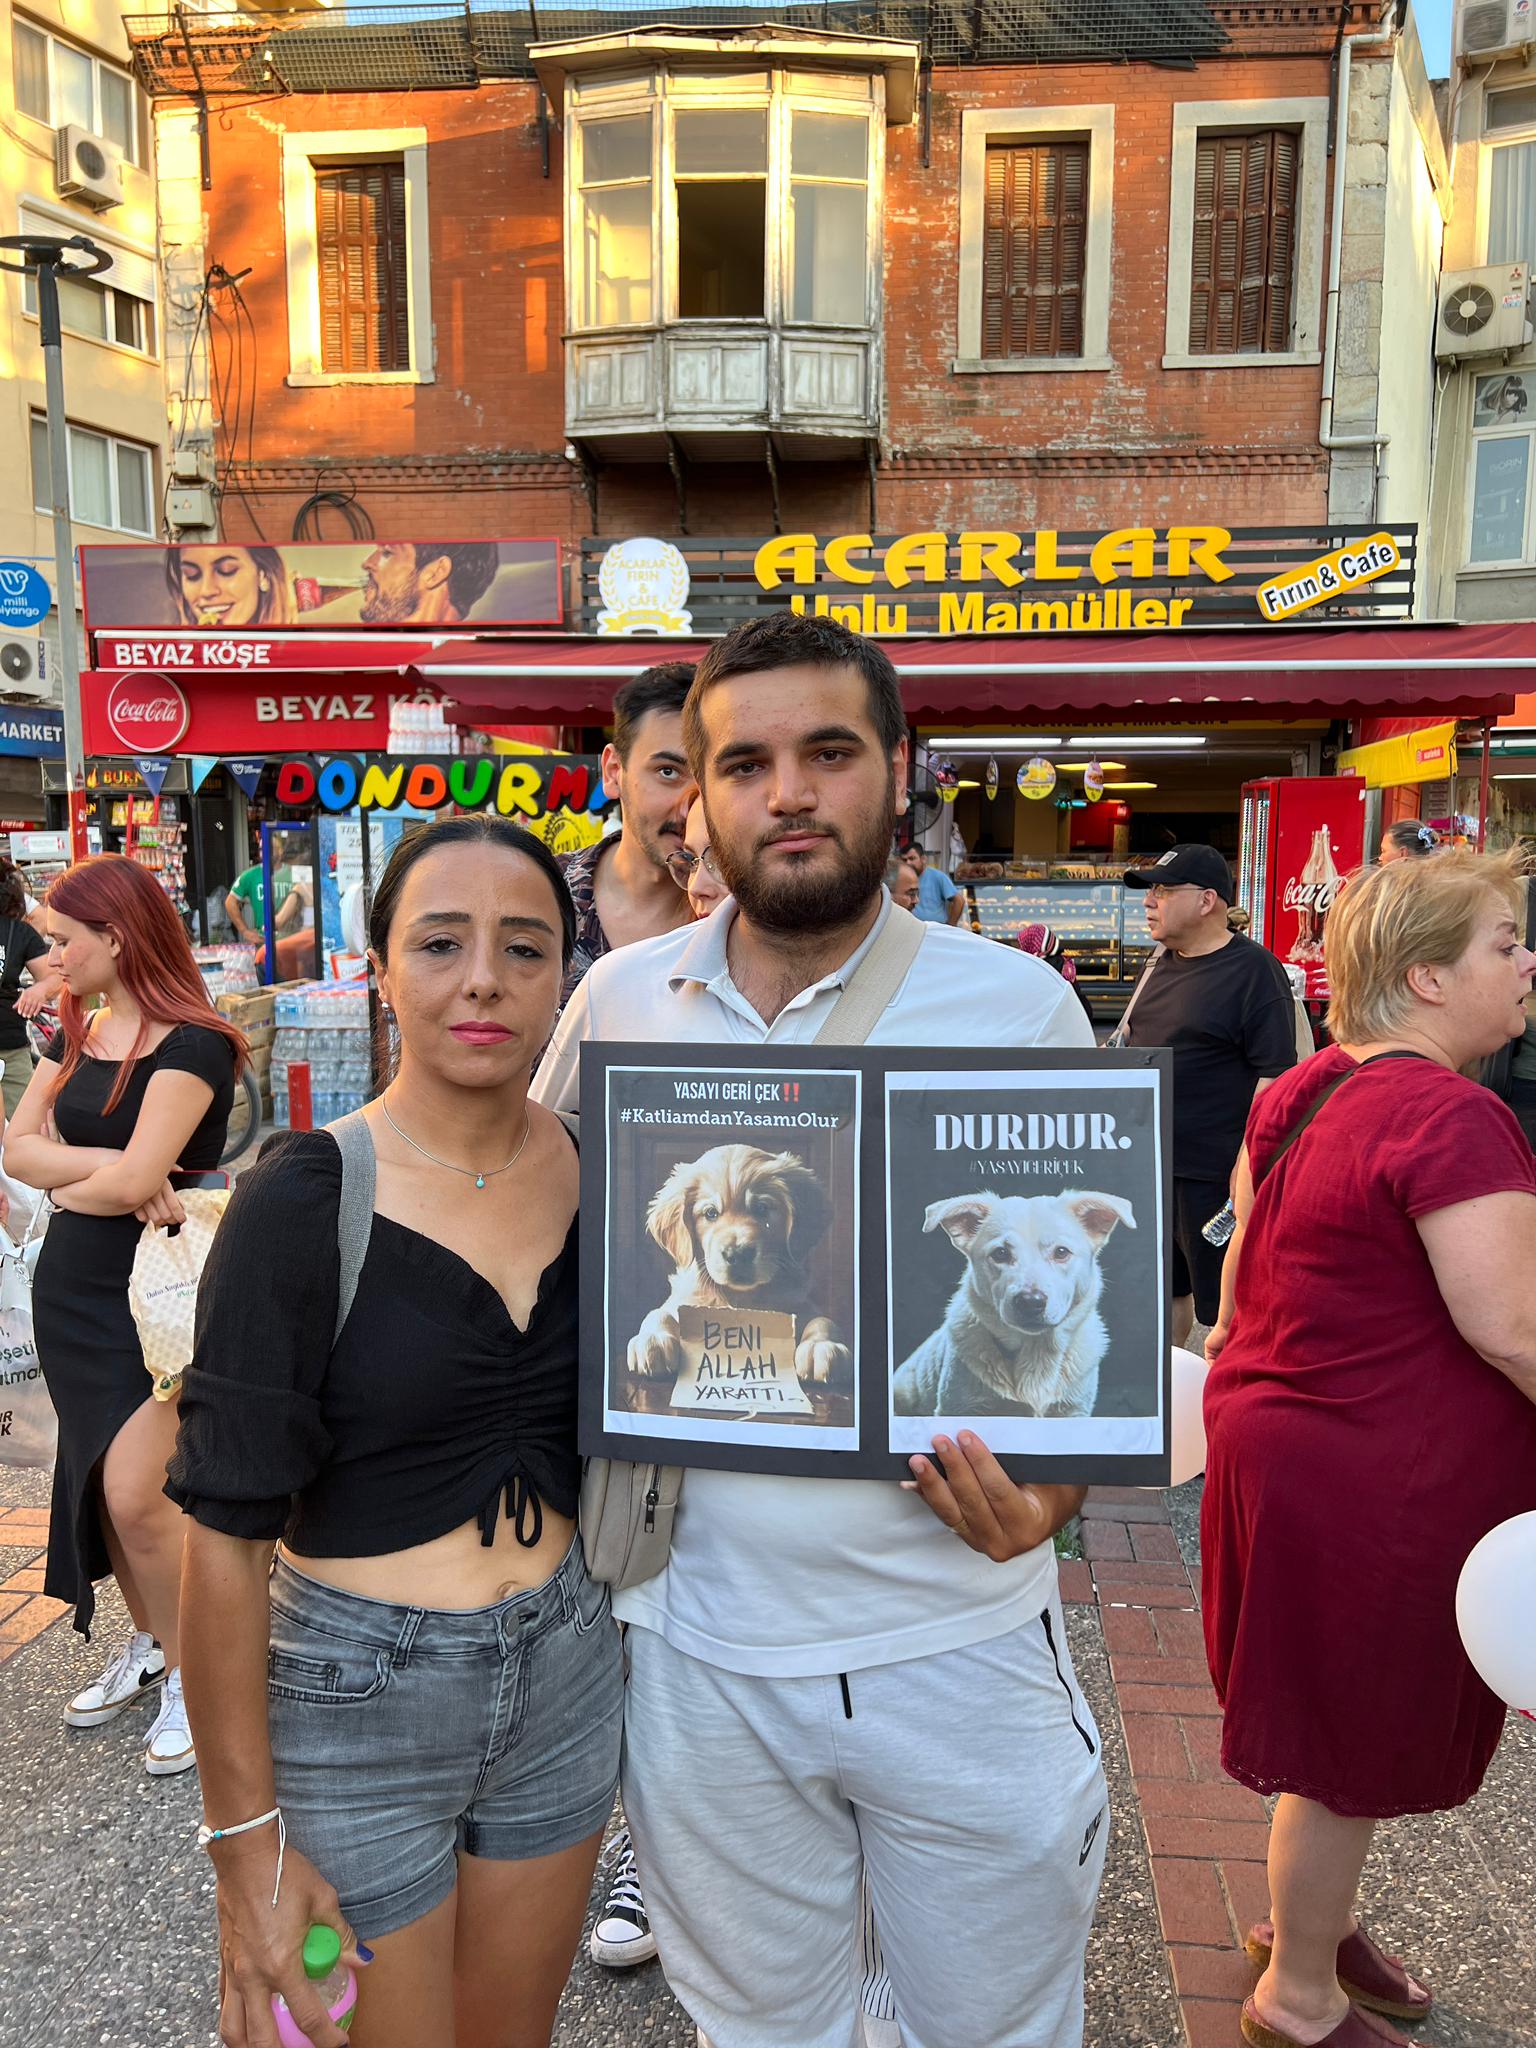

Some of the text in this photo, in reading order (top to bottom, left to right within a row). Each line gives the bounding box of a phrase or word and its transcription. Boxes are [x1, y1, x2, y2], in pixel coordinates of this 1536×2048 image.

[754, 526, 1235, 591] ACARLAR
[1264, 545, 1392, 612] Fırın & Cafe
[3, 597, 28, 607] milli
[939, 588, 1193, 634] Mamüller
[115, 641, 272, 670] BEYAZ KÖŞE
[113, 697, 179, 723] Coca-Cola
[256, 694, 375, 722] BEYAZ
[673, 1082, 719, 1100] YASAYI
[722, 1080, 751, 1101] GERİ
[933, 1113, 1132, 1151] DURDUR.
[696, 1352, 777, 1382] ALLAH
